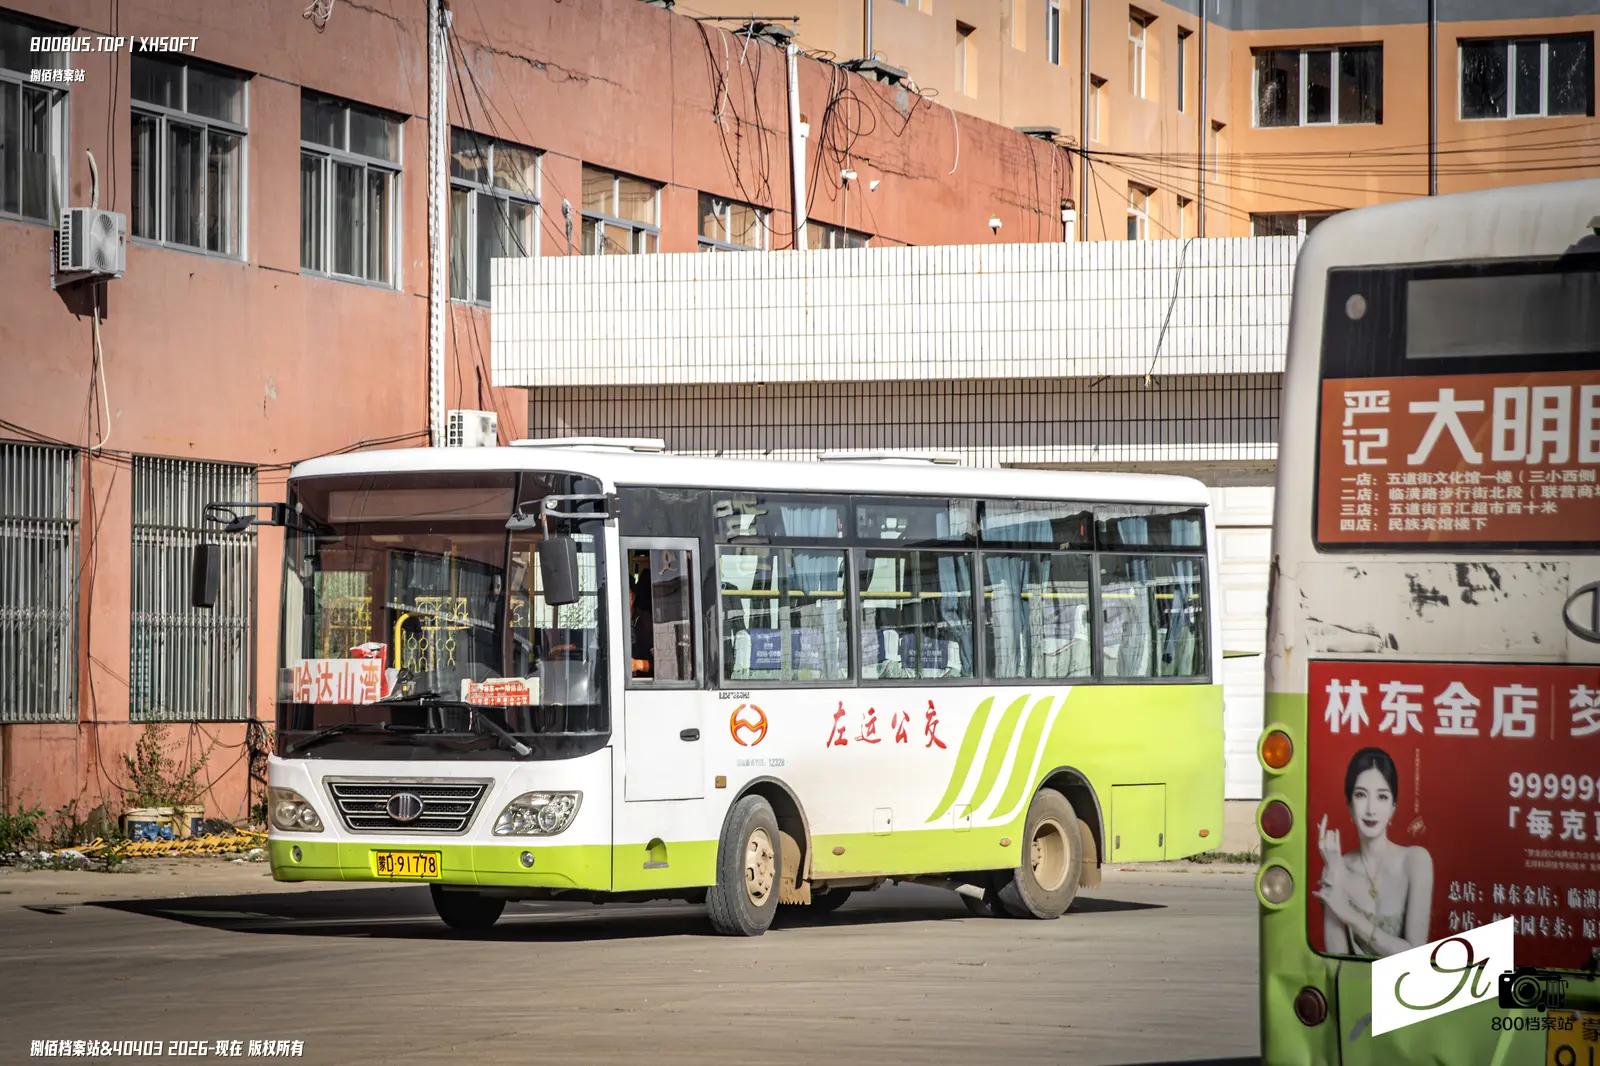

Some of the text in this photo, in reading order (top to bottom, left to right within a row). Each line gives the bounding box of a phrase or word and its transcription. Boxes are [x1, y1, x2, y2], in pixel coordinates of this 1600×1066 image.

[1342, 390, 1390, 465] 严记
[1407, 385, 1600, 465] 大明
[826, 699, 947, 750] 左运公交
[1323, 678, 1540, 738] 林东金店
[1508, 771, 1600, 803] 99999
[1508, 806, 1600, 842] 「每克
